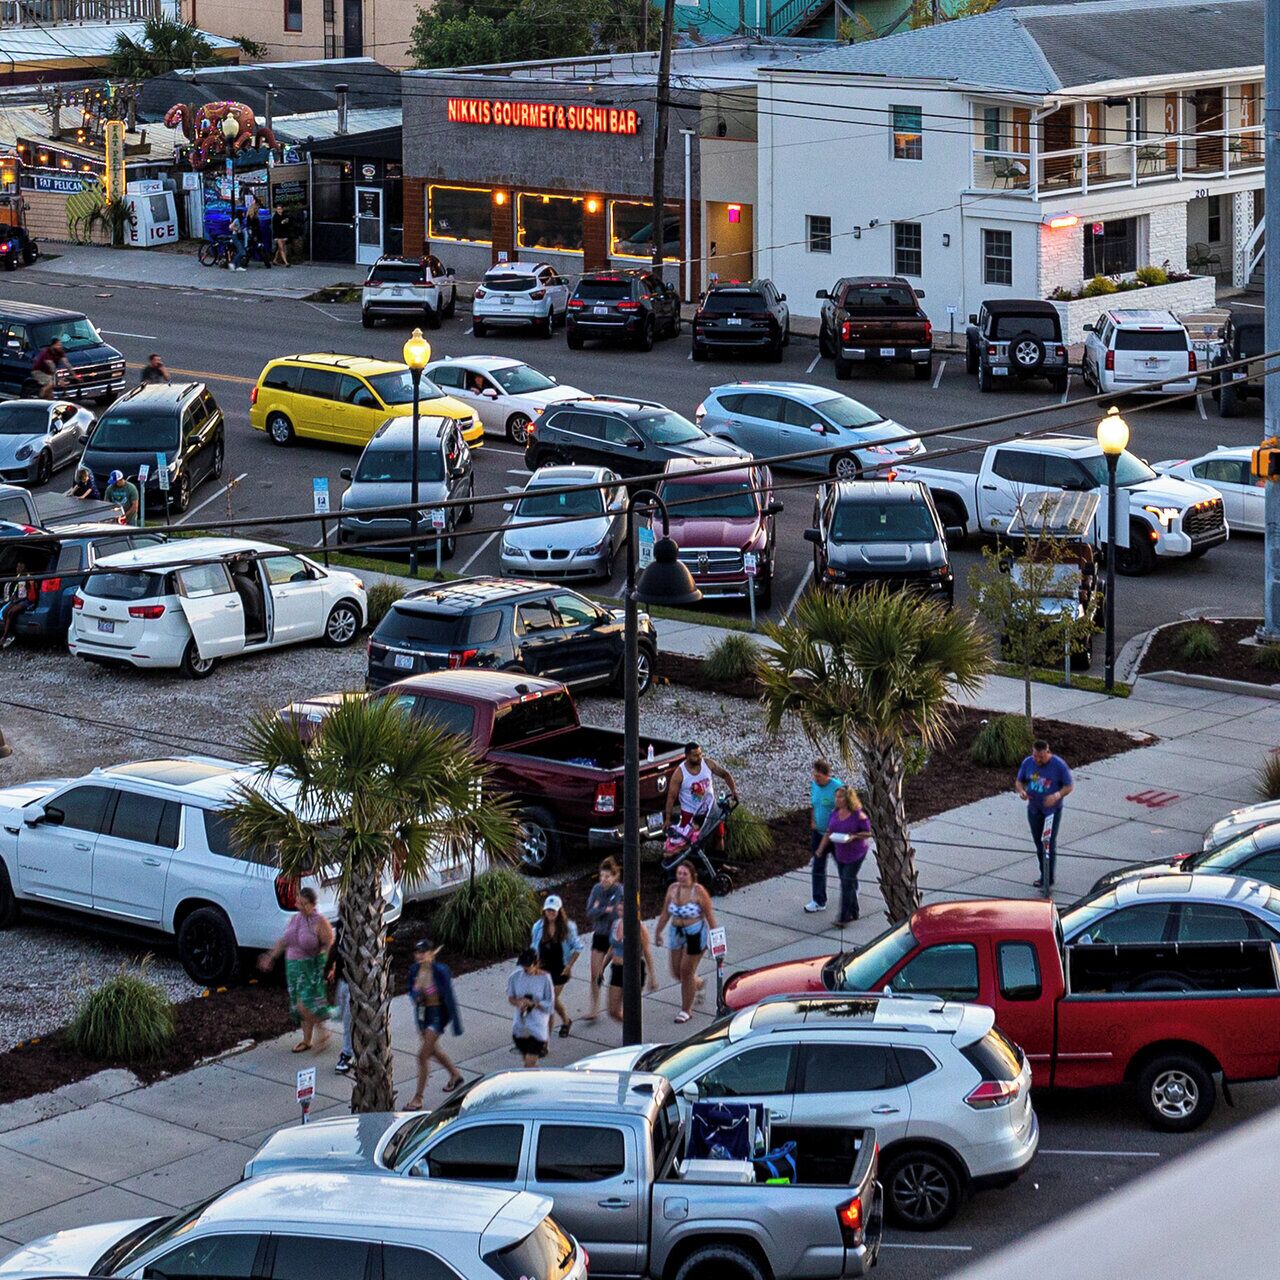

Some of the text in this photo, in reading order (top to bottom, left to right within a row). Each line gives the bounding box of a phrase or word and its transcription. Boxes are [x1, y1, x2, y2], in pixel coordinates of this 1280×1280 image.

[448, 98, 637, 135] NIKKIS GOURMET & SUSHI BAR
[39, 178, 83, 191] FAT PELICAN
[1195, 189, 1210, 198] 201
[129, 201, 138, 242] ICE
[150, 224, 175, 240] ICE
